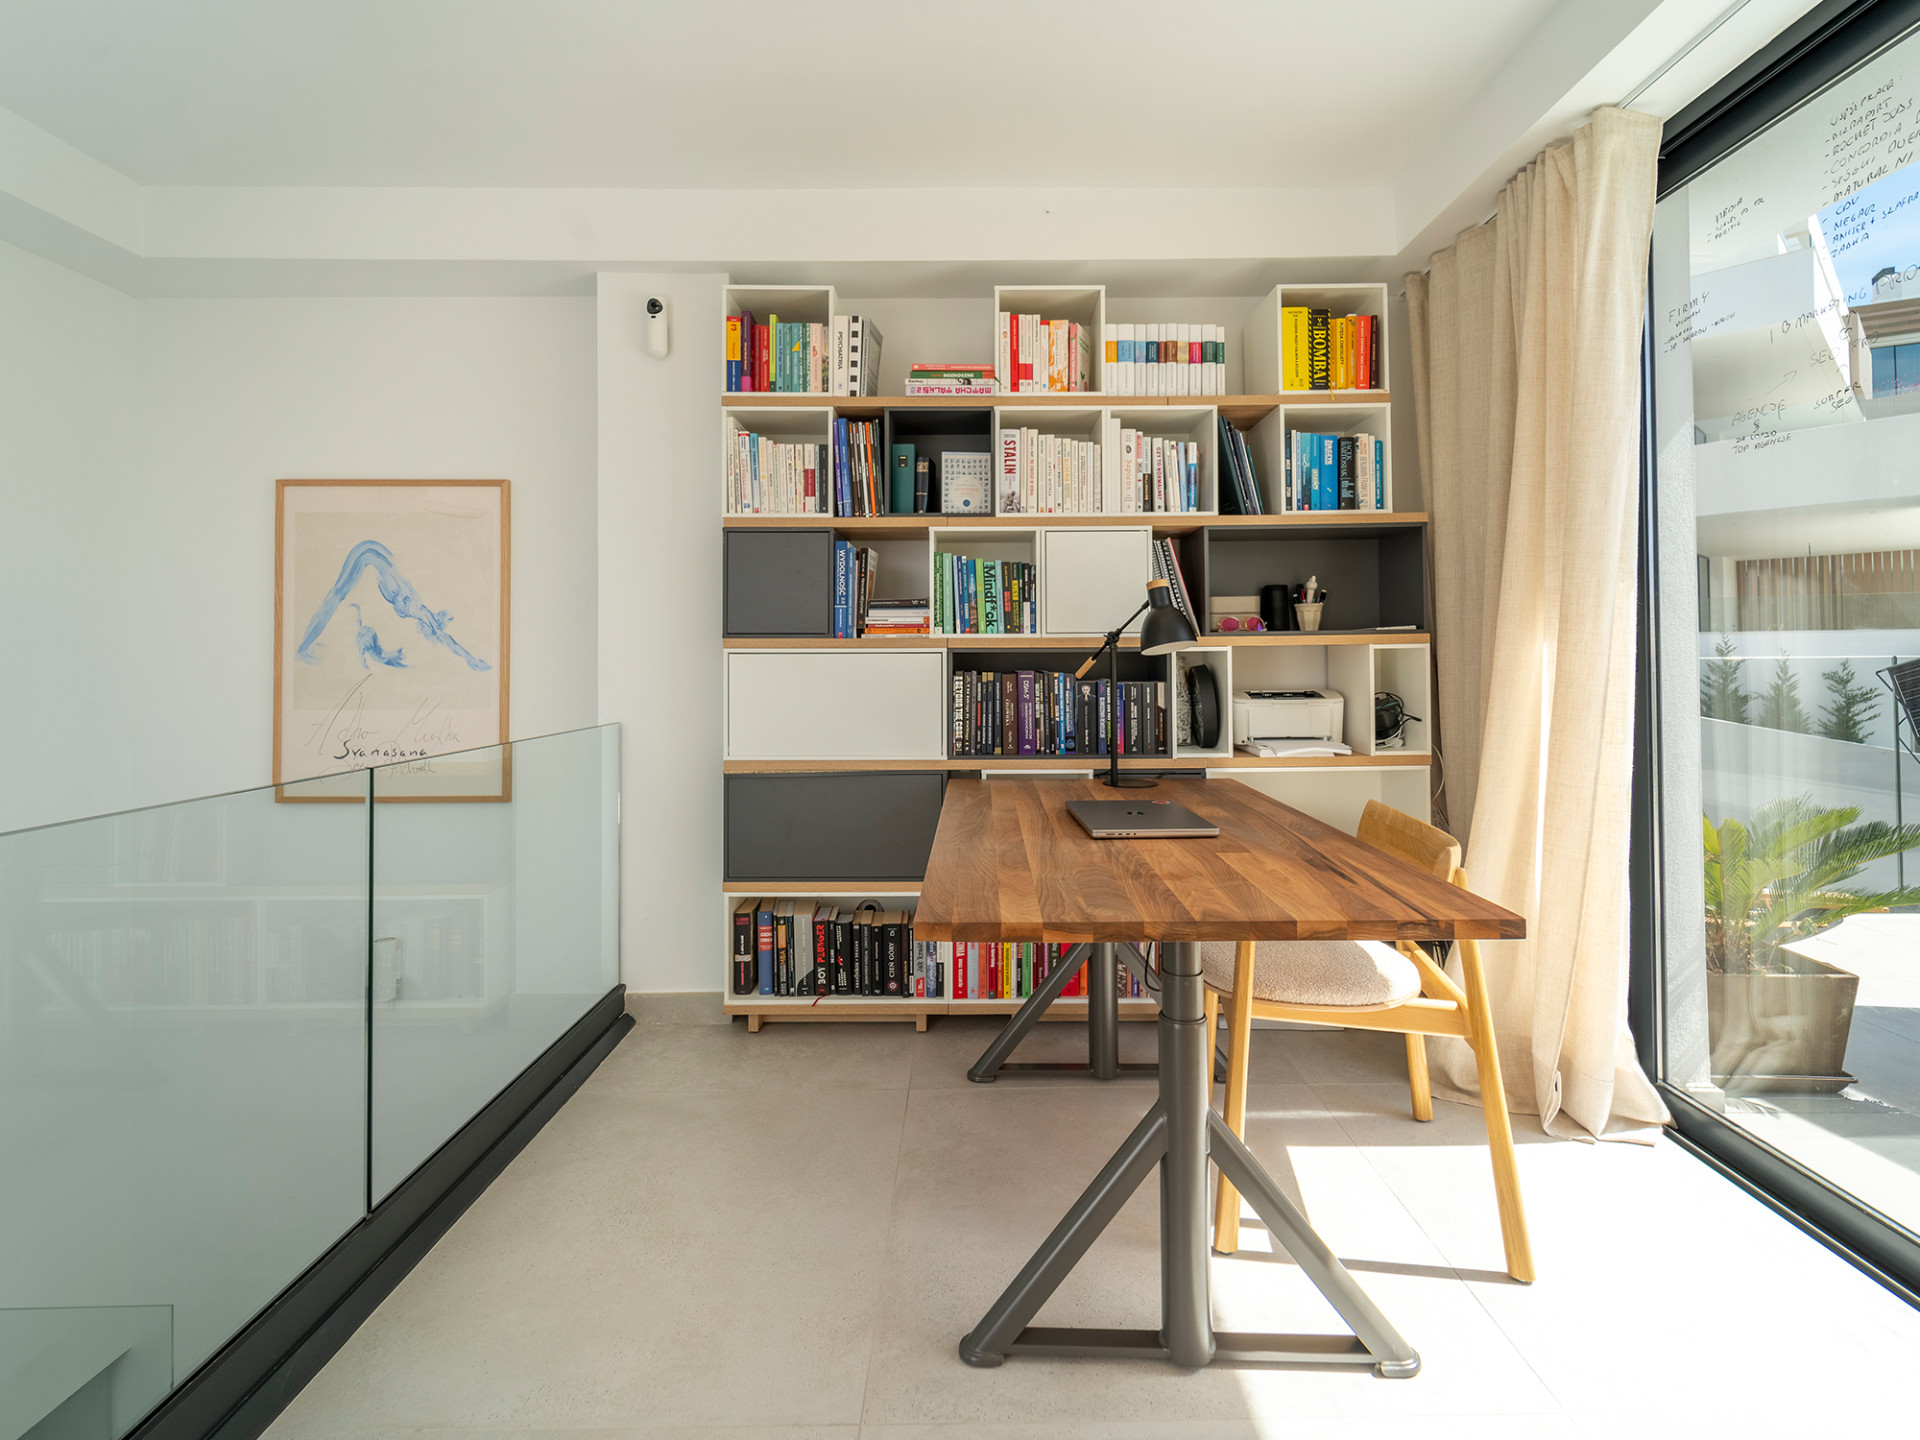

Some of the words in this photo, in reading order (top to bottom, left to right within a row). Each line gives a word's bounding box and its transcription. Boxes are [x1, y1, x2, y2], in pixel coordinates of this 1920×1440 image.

[1874, 262, 1920, 295] PRO
[1313, 330, 1327, 379] BOMBA
[1004, 440, 1017, 475] STALIN
[1124, 459, 1133, 490] Sapiens
[839, 549, 847, 596] WYDOLNOŚĆ
[955, 680, 963, 707] BEYOND
[955, 708, 963, 721] THE
[955, 721, 963, 739] CODE
[333, 739, 428, 760] Svanasana
[887, 941, 896, 961] GÓRY
[887, 962, 895, 978] CIEŃ
